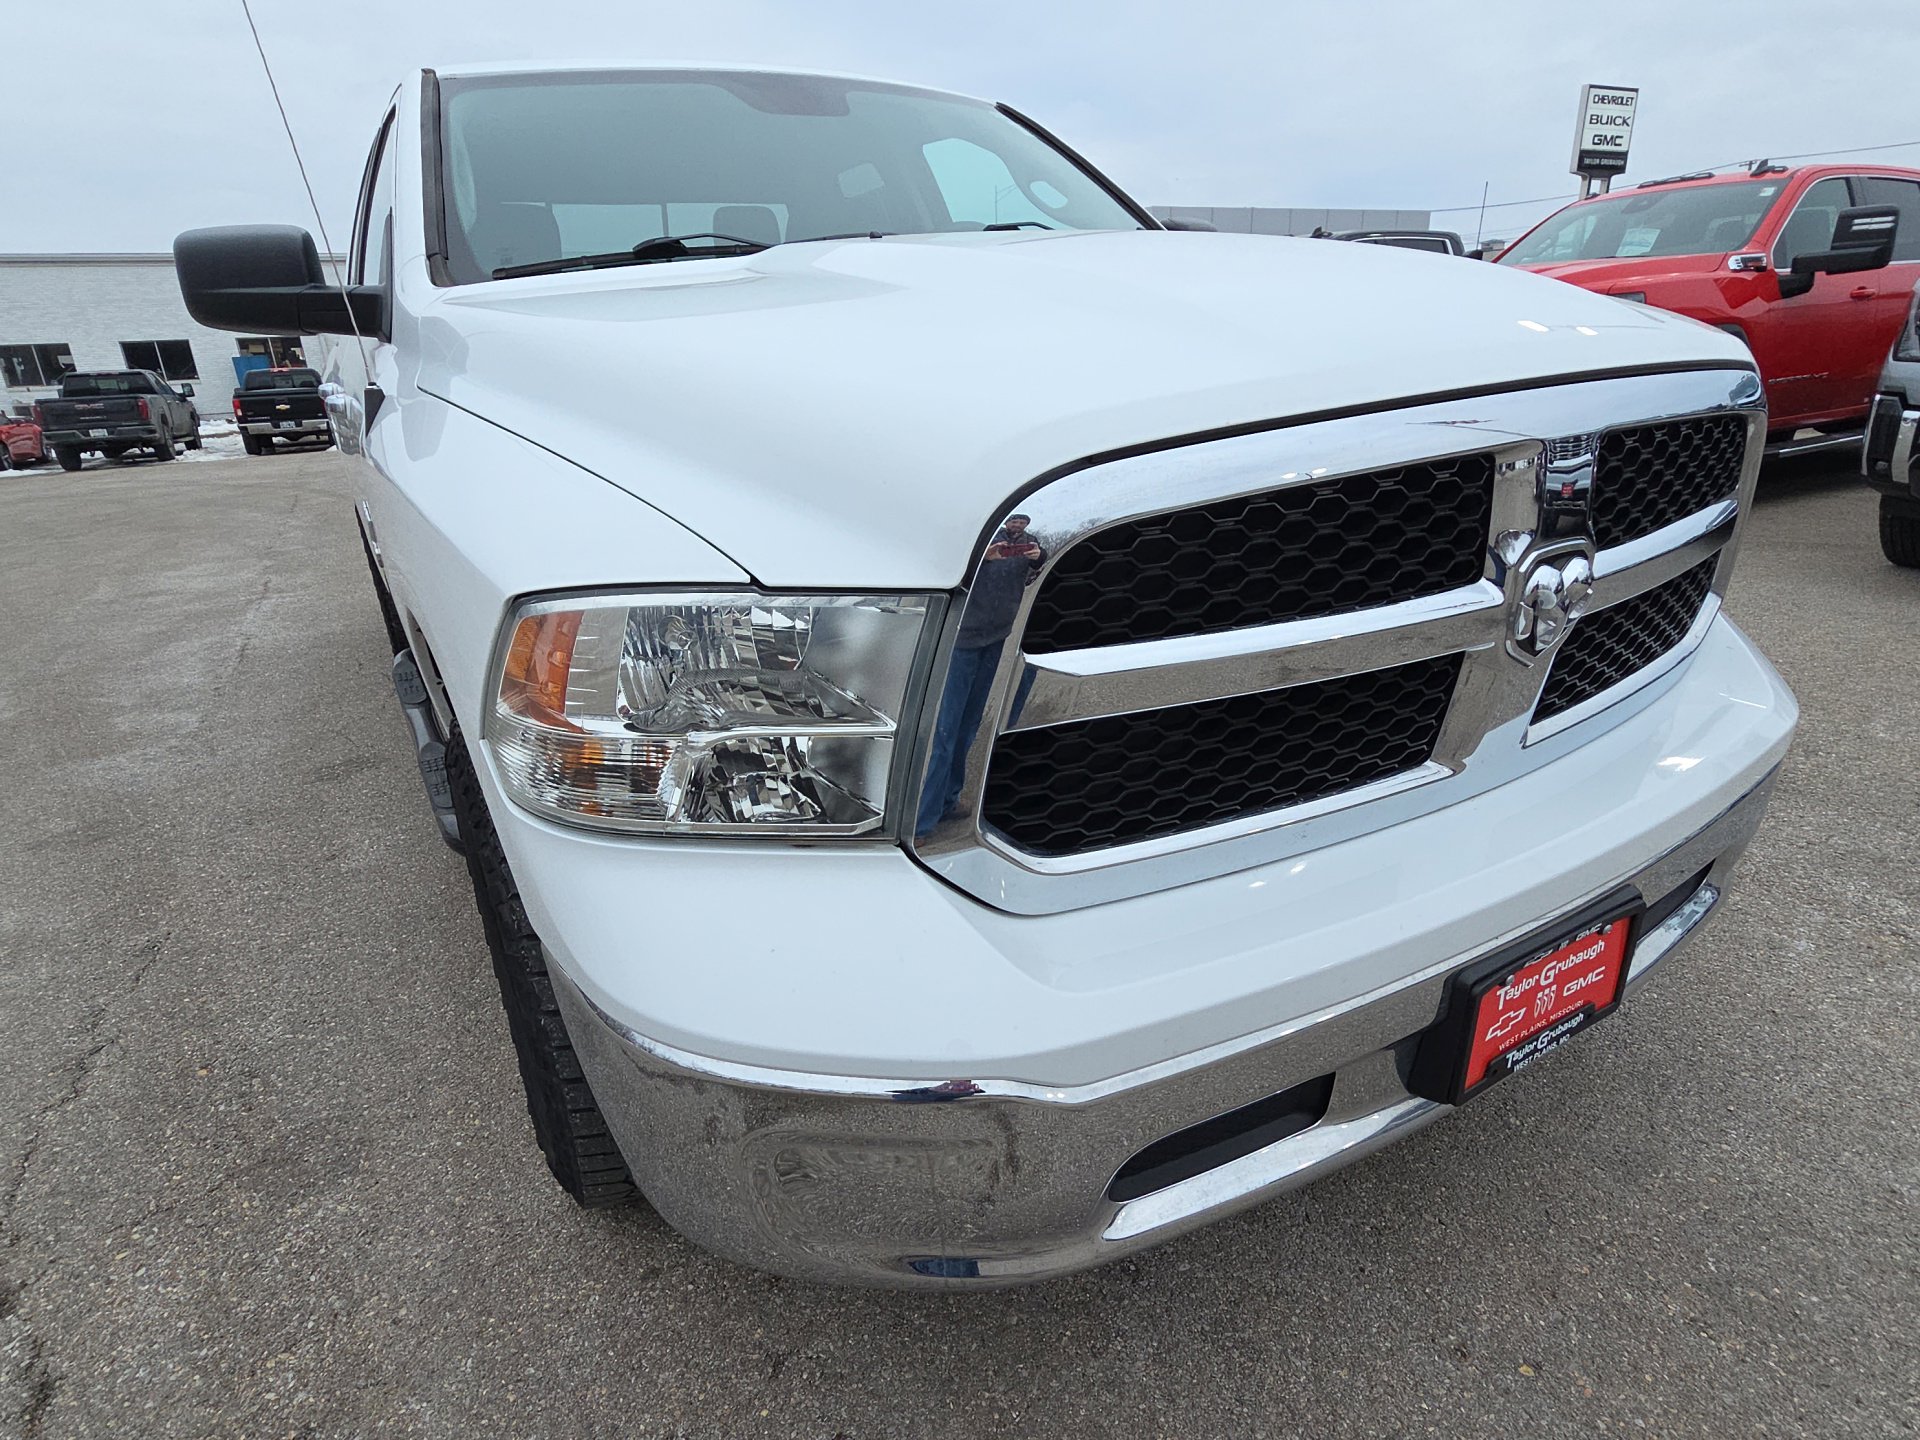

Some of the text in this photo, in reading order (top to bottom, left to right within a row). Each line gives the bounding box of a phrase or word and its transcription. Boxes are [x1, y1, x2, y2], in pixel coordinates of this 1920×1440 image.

[1593, 94, 1634, 106] CHEVROLET
[1589, 114, 1631, 127] BUICK
[1592, 134, 1623, 146] GMC
[1575, 923, 1602, 942] GMC
[1496, 939, 1605, 1010] Taylor Grubaugh
[1562, 965, 1606, 997] GMC
[1499, 1035, 1518, 1051] WEST
[1549, 999, 1584, 1022] MISSOURI
[1506, 1012, 1584, 1069] Taylor Grubaugh
[1513, 1055, 1534, 1073] WEST
[1559, 1033, 1570, 1046] MO
